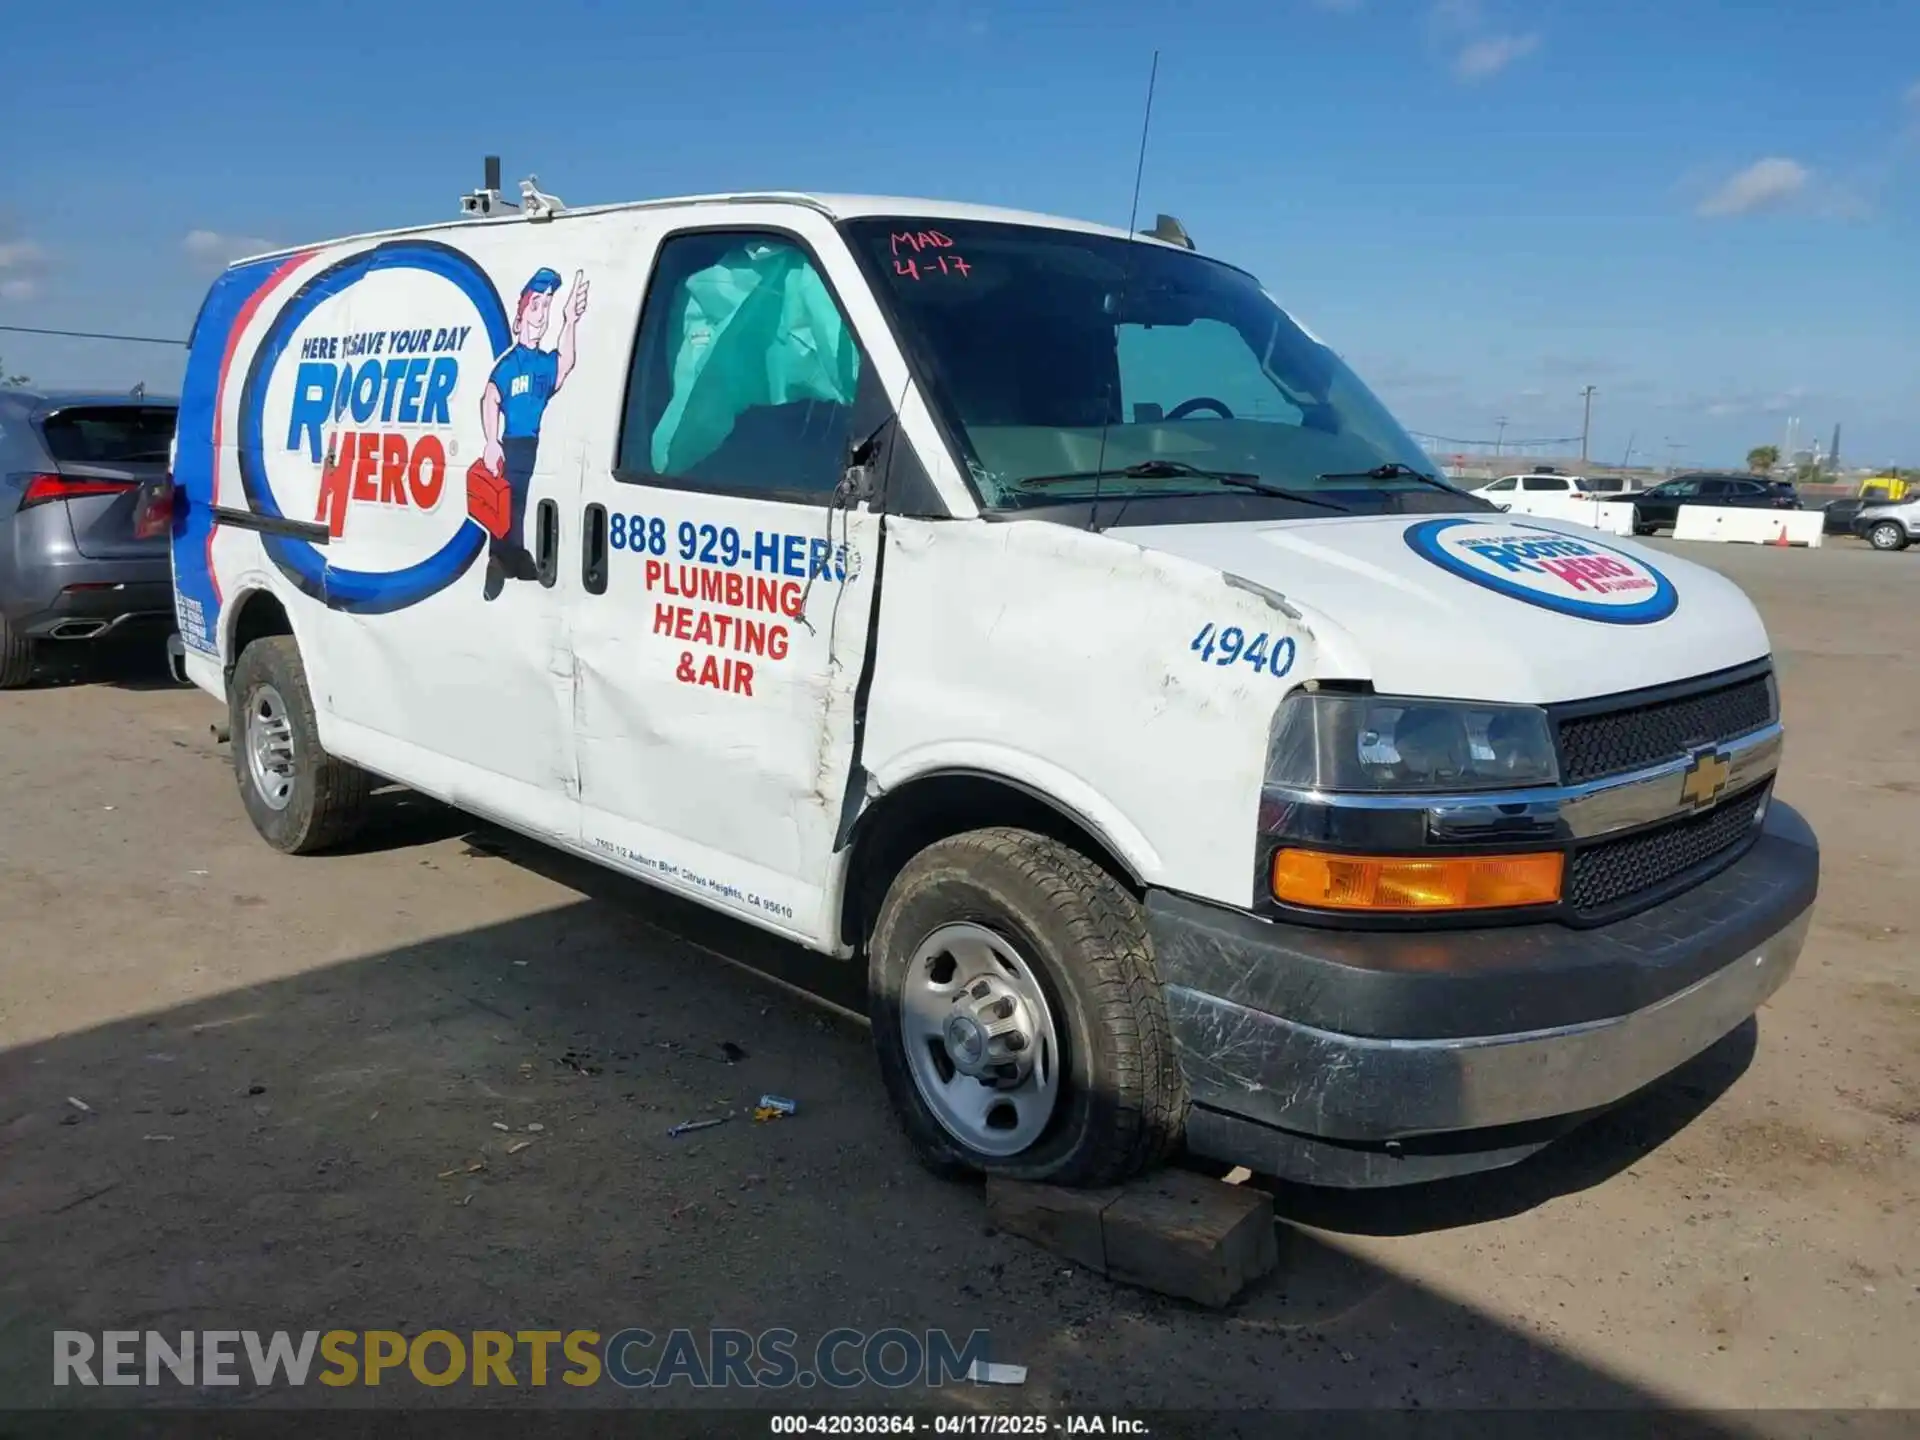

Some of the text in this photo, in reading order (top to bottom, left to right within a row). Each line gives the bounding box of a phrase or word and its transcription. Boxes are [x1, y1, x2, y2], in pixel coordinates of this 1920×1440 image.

[891, 230, 953, 256] MAD
[893, 255, 971, 280] 4-17
[300, 337, 338, 359] HERE
[351, 331, 386, 356] SAVE
[388, 329, 432, 354] YOUR
[433, 326, 471, 351] DAY
[286, 357, 459, 464] ROOTER
[315, 432, 447, 538] HERO
[610, 512, 666, 556] 888
[645, 560, 801, 618] PLUMBING
[653, 603, 789, 660] HEATING
[1190, 622, 1296, 678] 4940
[676, 651, 754, 697] &AIR
[681, 868, 707, 886] Citrus
[709, 879, 744, 902] Heights,
[747, 893, 760, 906] CA
[763, 899, 793, 918] 95610
